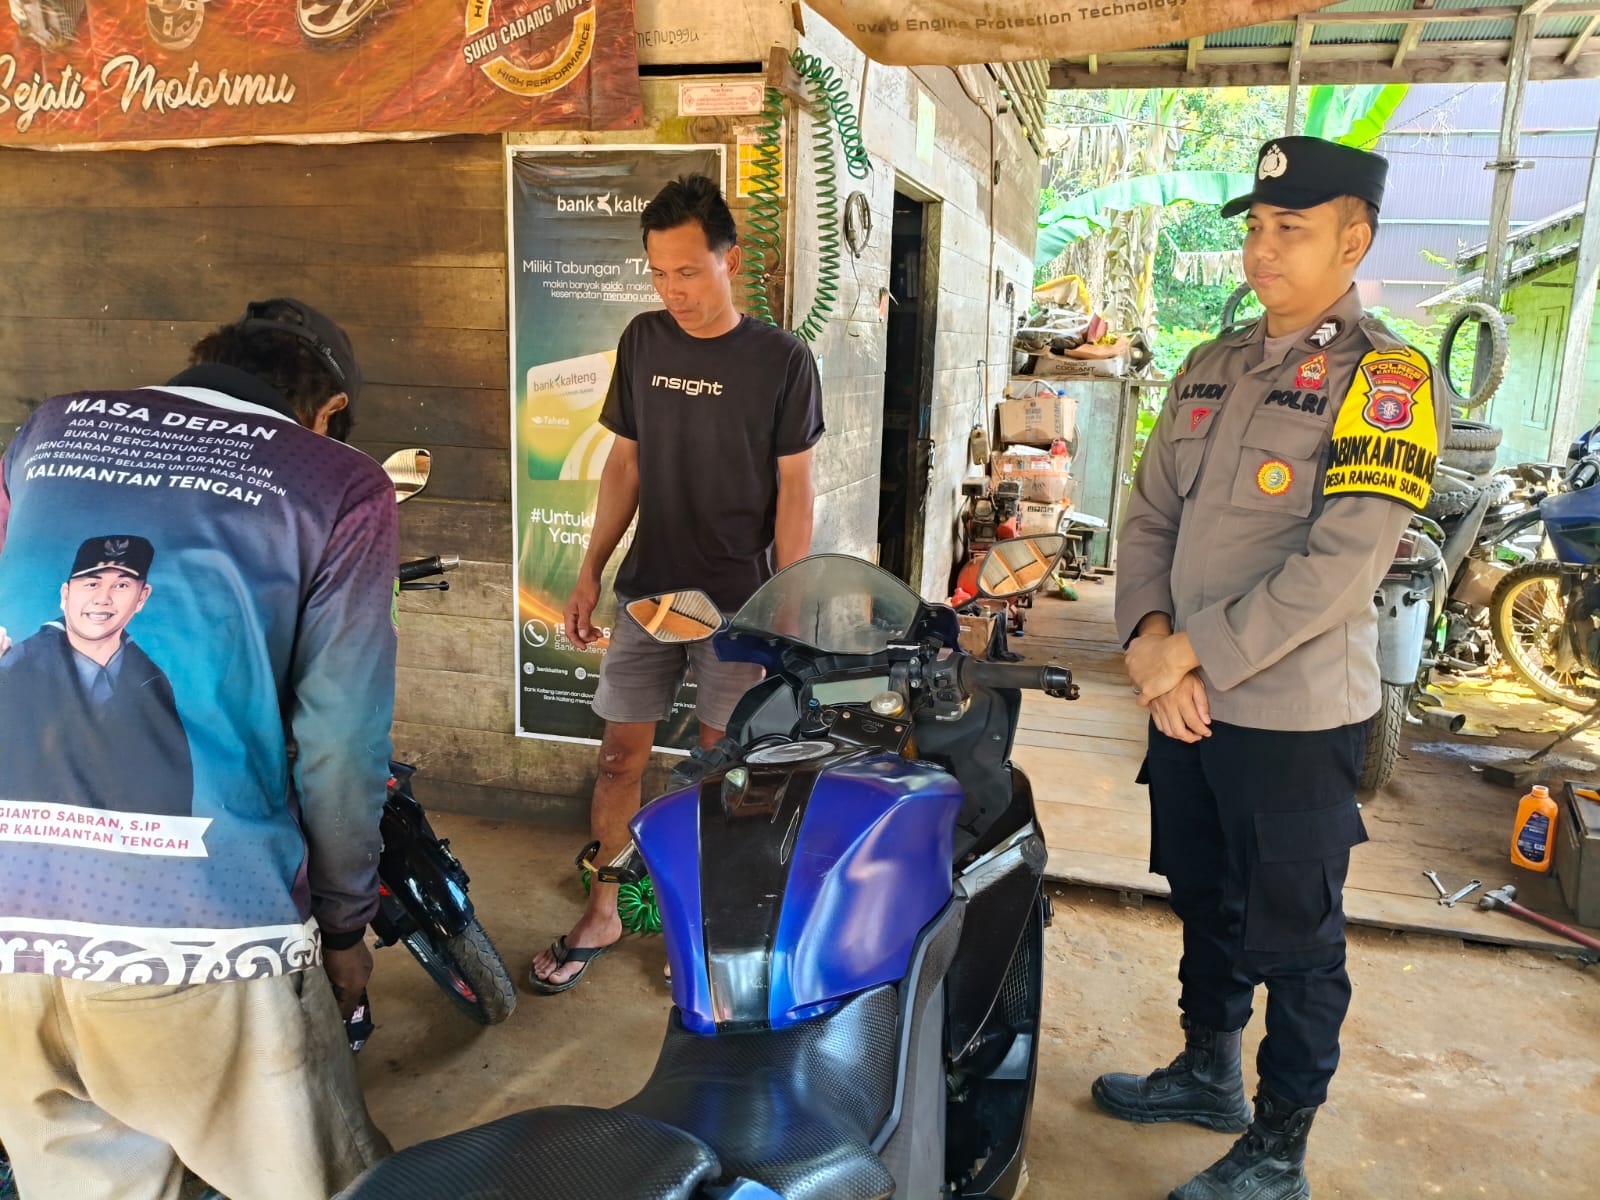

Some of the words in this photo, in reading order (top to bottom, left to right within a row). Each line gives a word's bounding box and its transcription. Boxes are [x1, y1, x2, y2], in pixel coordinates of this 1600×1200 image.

[906, 17, 970, 32] Engine
[975, 11, 1072, 30] Protection
[464, 34, 498, 64] SUKU
[500, 4, 552, 45] CADANG
[496, 68, 525, 87] HIGH
[526, 23, 591, 88] PERFORMANCE
[0, 54, 86, 133] Sejati
[101, 54, 296, 114] Motormu
[557, 195, 594, 212] bank
[523, 260, 552, 273] Miliki
[554, 261, 620, 277] Tabungan
[543, 280, 568, 289] makin
[569, 280, 600, 292] banyak
[626, 283, 653, 292] makin
[551, 291, 602, 300] kesempatan
[603, 292, 638, 303] menang
[1056, 364, 1096, 373] COOLANT
[1369, 362, 1423, 380] POLRES
[534, 379, 555, 392] bank
[560, 371, 597, 386] kalteng
[651, 374, 724, 396] insight
[1264, 389, 1328, 415] POLRI
[65, 398, 150, 421] MASA
[161, 411, 278, 441] DEPAN
[64, 429, 109, 441] BUKAN
[113, 435, 208, 453] BERGANTUNG
[211, 447, 251, 460] ATAU
[68, 418, 95, 428] ADA
[98, 420, 194, 442] DITANGANMU
[197, 436, 254, 450] SENDIRI
[35, 440, 141, 458] MENGHARAPKAN
[144, 451, 181, 462] PADA
[186, 455, 237, 468] ORANG
[240, 463, 273, 479] LAIN
[26, 463, 162, 487] KALIMANTAN
[168, 475, 263, 506] TENGAH
[53, 451, 113, 464] SEMANGAT
[115, 458, 165, 470] BELAJAR
[168, 464, 207, 472] UNTUK
[210, 467, 243, 481] MASA
[247, 476, 287, 497] DEPAN
[1325, 471, 1346, 488] DESA
[1349, 470, 1397, 489] RANGAN
[548, 527, 591, 549] Yang
[554, 642, 575, 652] Bank
[57, 811, 123, 830] SABRAN,
[129, 820, 160, 832] S.IP
[14, 824, 113, 844] KALIMANTAN
[121, 835, 189, 849] TENGAH
